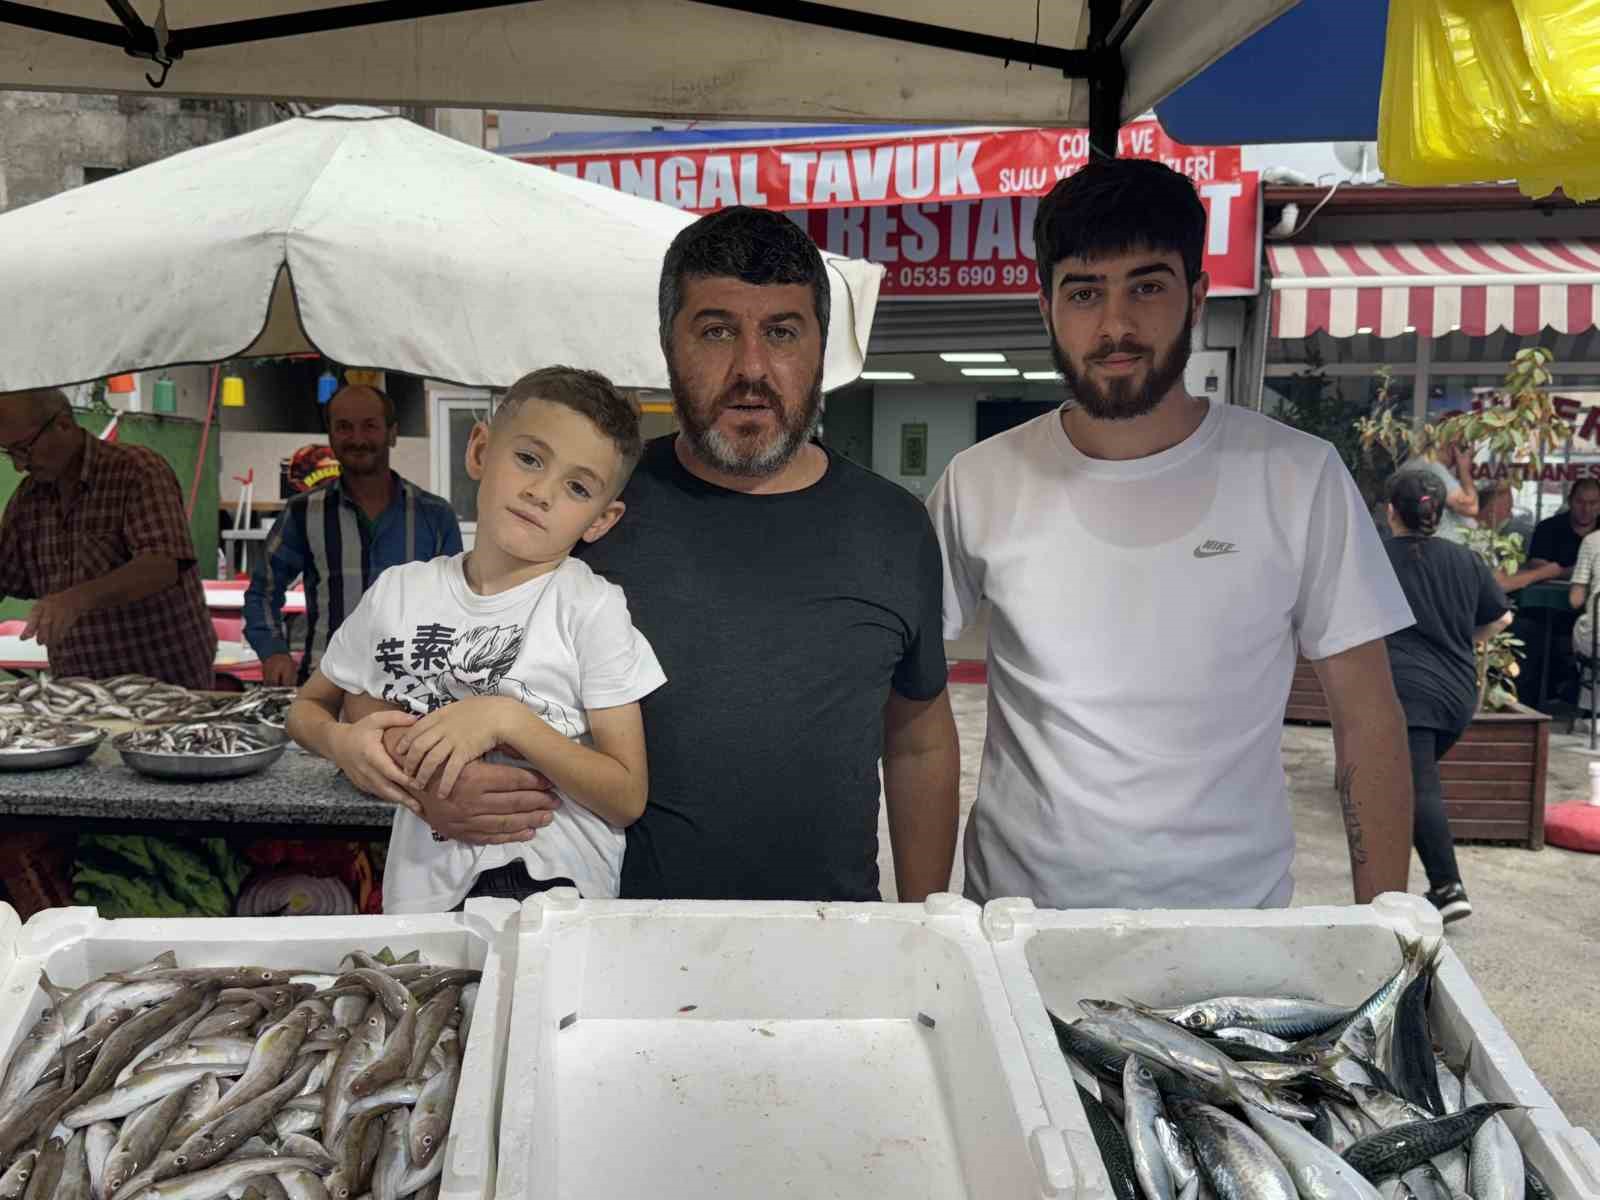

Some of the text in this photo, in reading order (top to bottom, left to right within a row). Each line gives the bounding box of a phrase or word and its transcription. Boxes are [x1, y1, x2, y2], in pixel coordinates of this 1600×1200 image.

[1130, 129, 1154, 154] VE
[543, 139, 982, 209] ANGAL TAVUK
[999, 167, 1048, 193] SULU
[900, 267, 950, 287] 0535
[957, 265, 996, 287] 690
[1002, 265, 1028, 286] 99
